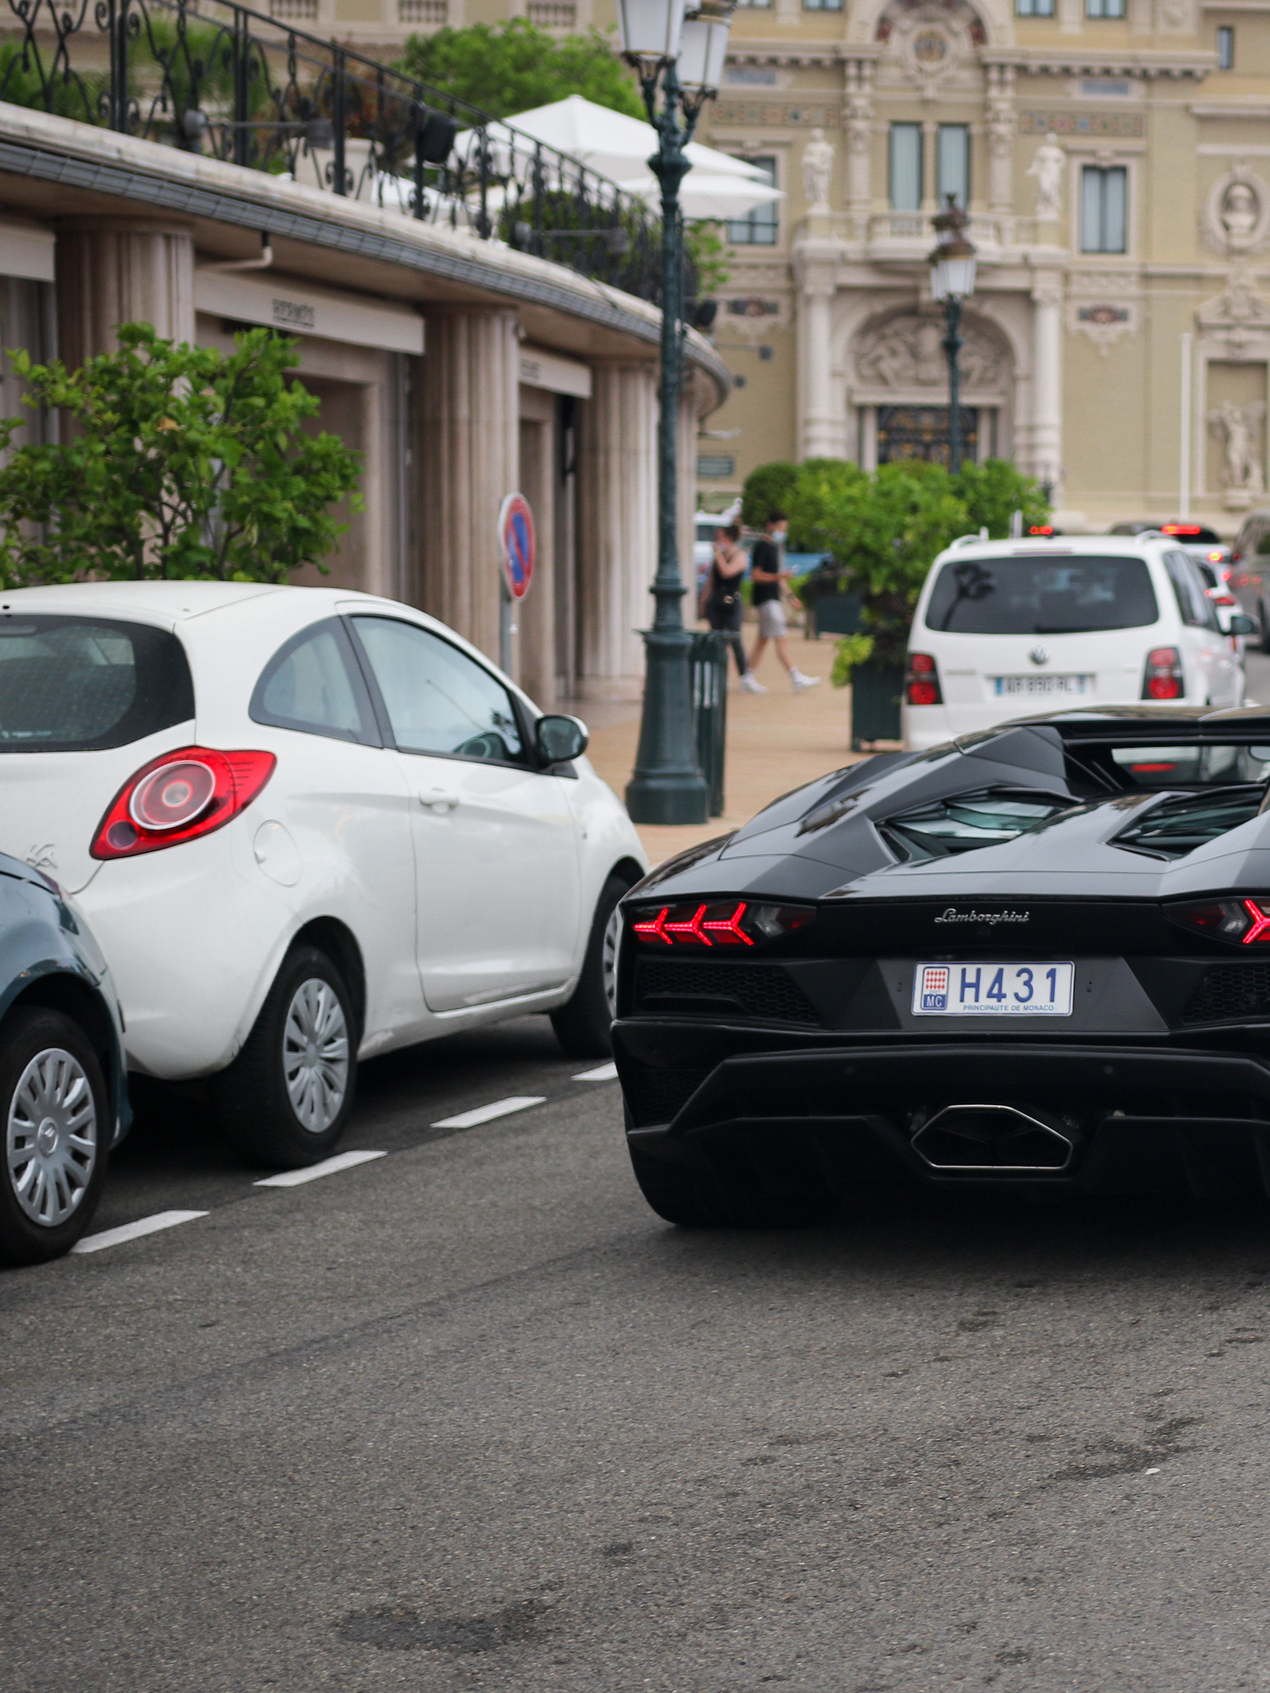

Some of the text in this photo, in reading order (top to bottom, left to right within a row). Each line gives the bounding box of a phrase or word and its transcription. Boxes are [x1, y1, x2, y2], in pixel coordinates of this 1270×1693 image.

[934, 908, 1030, 925] Lamborghini
[959, 967, 1057, 1003] H431
[926, 995, 943, 1007] MC
